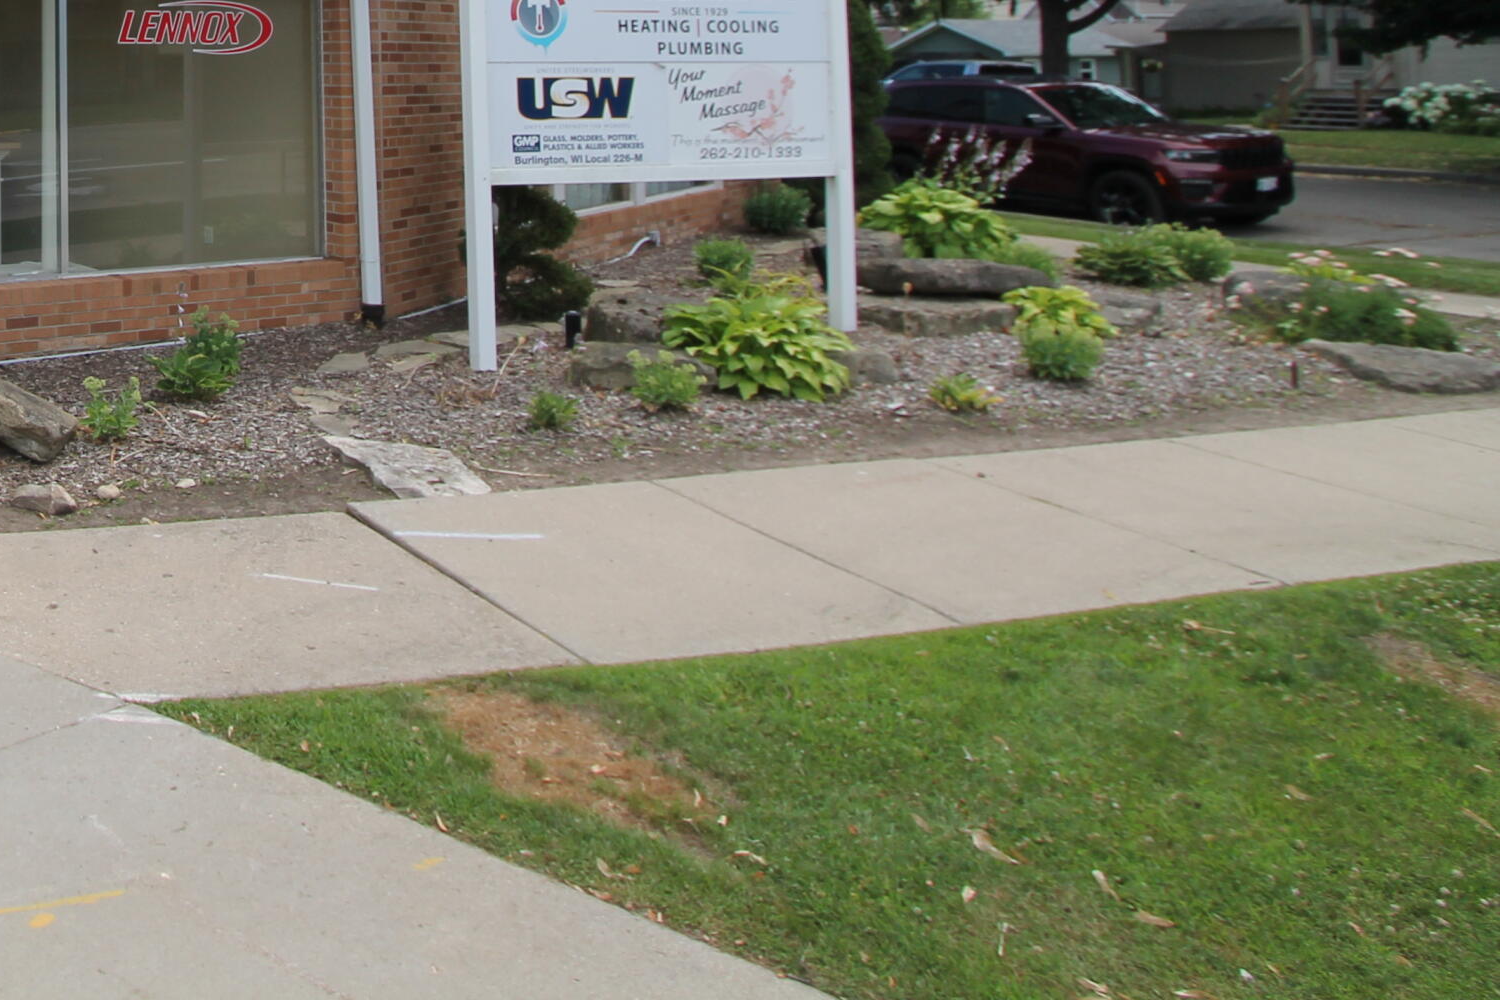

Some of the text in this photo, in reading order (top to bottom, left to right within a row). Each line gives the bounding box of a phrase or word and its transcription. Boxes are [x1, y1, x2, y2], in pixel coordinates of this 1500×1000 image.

[671, 7, 729, 17] SINCE 1929
[117, 9, 244, 45] LENNOX
[618, 19, 780, 33] HEATING COOLING
[657, 42, 744, 55] PLUMBING
[668, 68, 706, 90] Your
[516, 77, 635, 120] USW
[680, 81, 742, 103] Moment
[699, 99, 766, 120] Massage
[513, 135, 539, 147] GMP
[543, 143, 575, 151] PLASTICS
[585, 142, 607, 150] ALLIED
[514, 153, 643, 167] Burlington, WI Local 226-M
[700, 146, 803, 160] 262-210-1333
